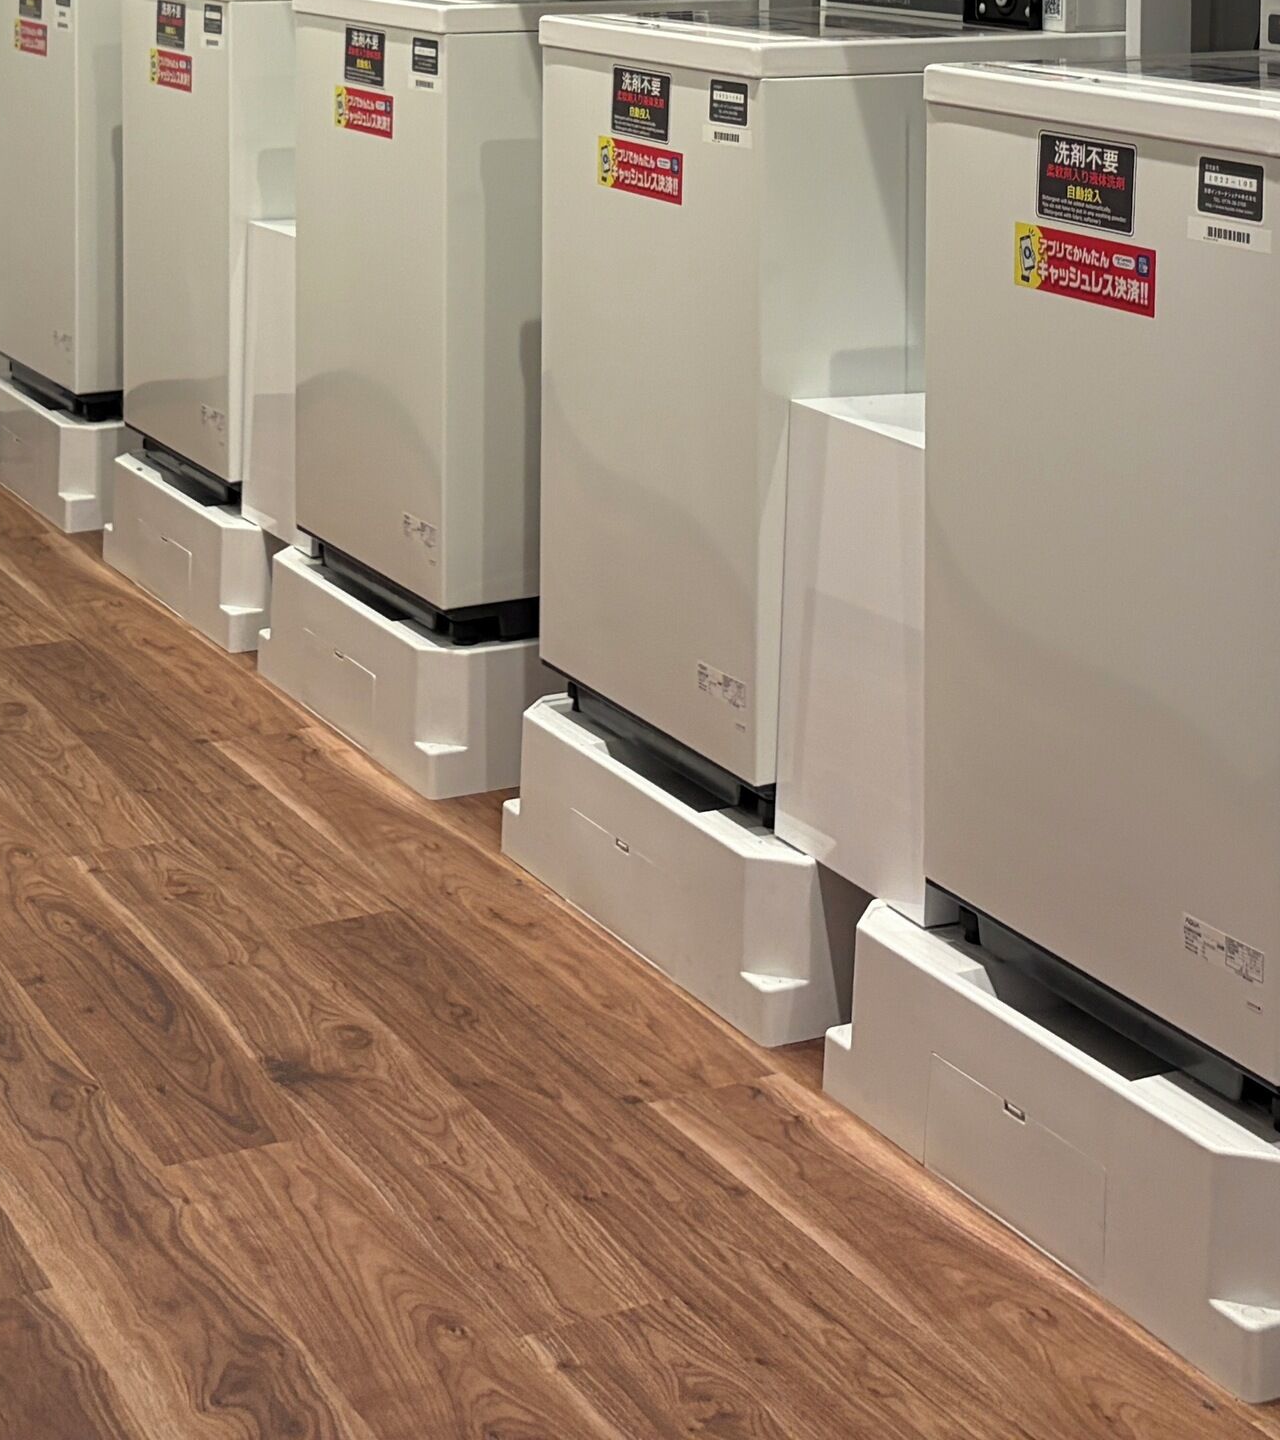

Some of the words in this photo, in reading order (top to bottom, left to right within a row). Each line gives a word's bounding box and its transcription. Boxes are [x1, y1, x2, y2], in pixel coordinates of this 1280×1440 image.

[621, 71, 662, 96] 洗剤不要
[1054, 140, 1119, 174] 洗剤不要
[1066, 184, 1102, 204] 自動投入
[1037, 238, 1110, 269] アプリでかんたん
